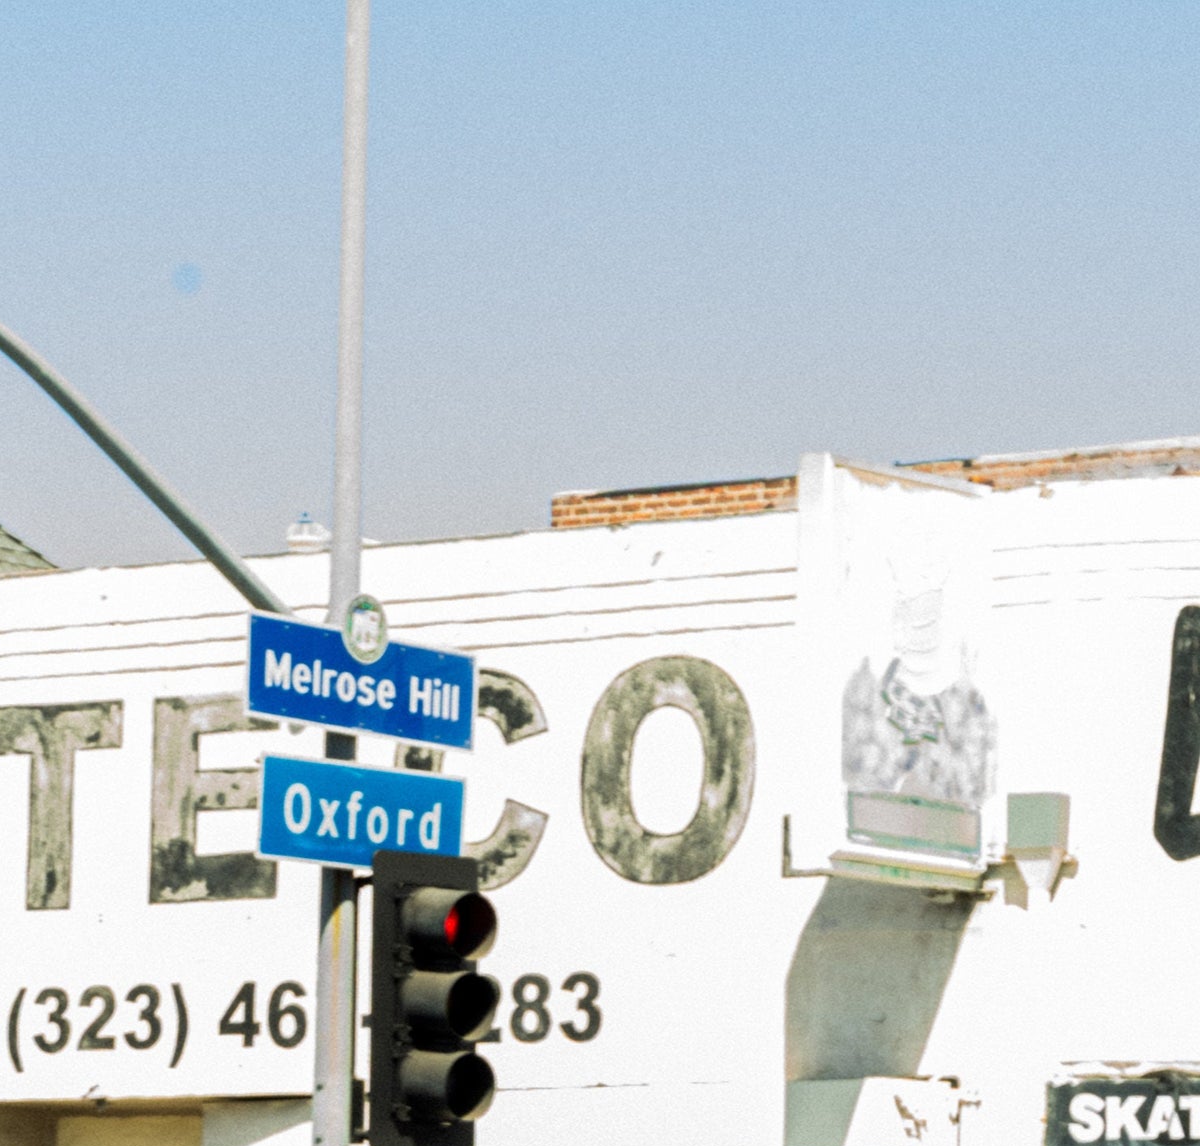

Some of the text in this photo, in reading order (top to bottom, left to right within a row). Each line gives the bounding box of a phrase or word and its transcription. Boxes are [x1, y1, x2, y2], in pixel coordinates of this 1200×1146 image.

[264, 648, 461, 723] Melrose Hill
[282, 782, 443, 851] Oxford
